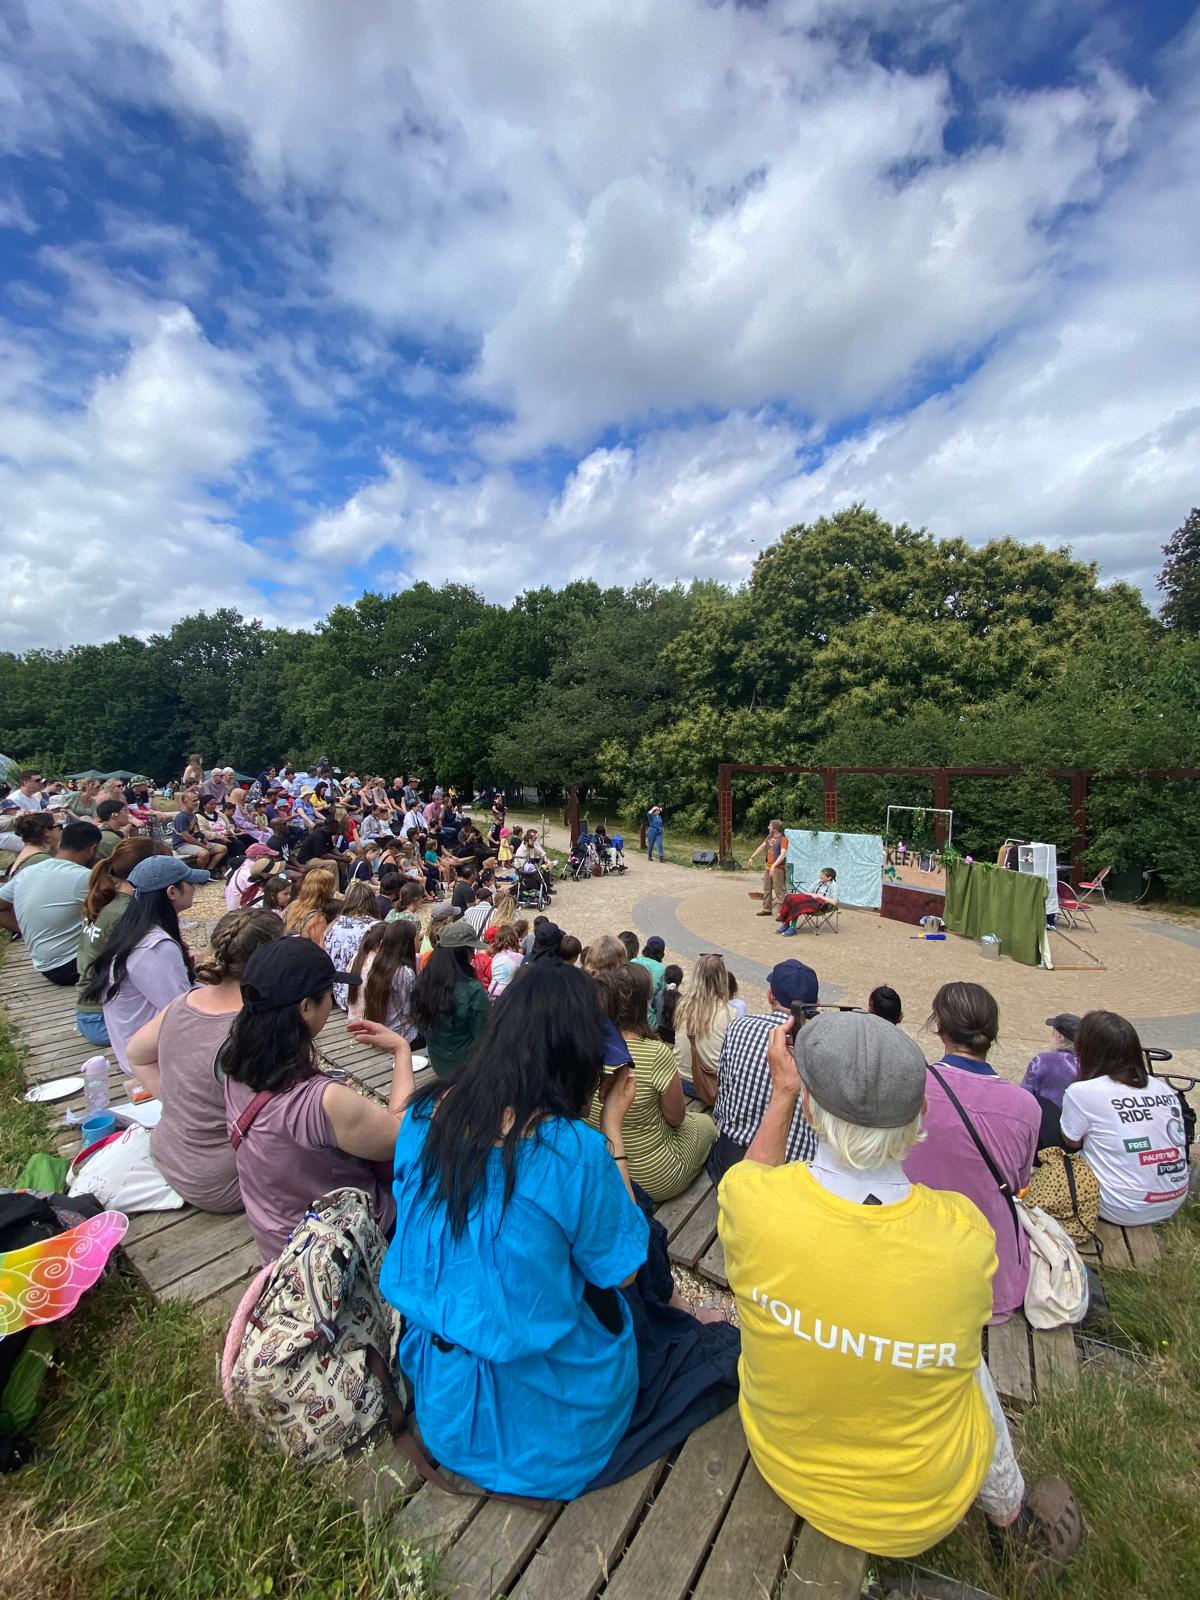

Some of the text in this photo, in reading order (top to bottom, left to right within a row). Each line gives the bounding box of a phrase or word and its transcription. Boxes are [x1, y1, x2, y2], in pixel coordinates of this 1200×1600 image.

[1118, 1109, 1153, 1123] RIDE
[1128, 1141, 1149, 1150] FREE
[1142, 1151, 1176, 1162] PALESTINE
[278, 1315, 298, 1330] Damon
[752, 1287, 956, 1369] VOLUNTEER
[287, 1370, 312, 1398] Damon
[313, 1414, 340, 1435] Damon
